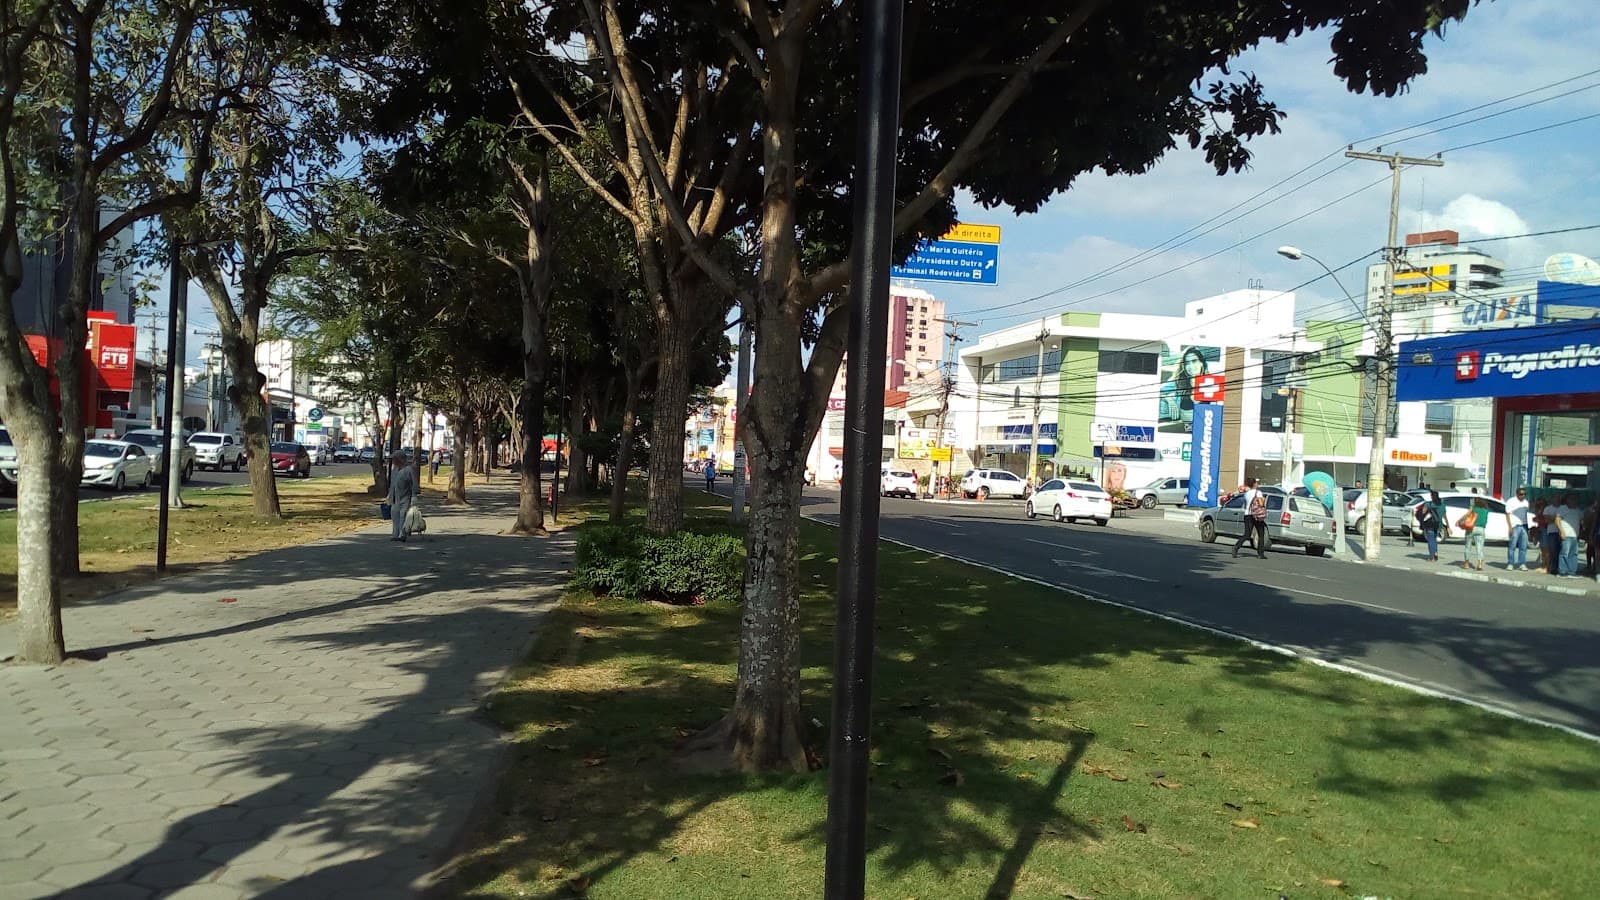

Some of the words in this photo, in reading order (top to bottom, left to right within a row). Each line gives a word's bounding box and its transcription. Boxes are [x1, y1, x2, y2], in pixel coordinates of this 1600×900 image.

[961, 229, 992, 238] direita
[929, 245, 951, 254] Maria
[952, 247, 983, 256] Quitéria
[916, 256, 958, 266] Presidente
[960, 258, 982, 268] Dutra
[893, 265, 927, 275] Terminal
[928, 268, 970, 278] Rodoviário
[1462, 295, 1531, 325] CAIXA
[101, 351, 128, 364] FTB
[1198, 409, 1213, 502] PagueMenos
